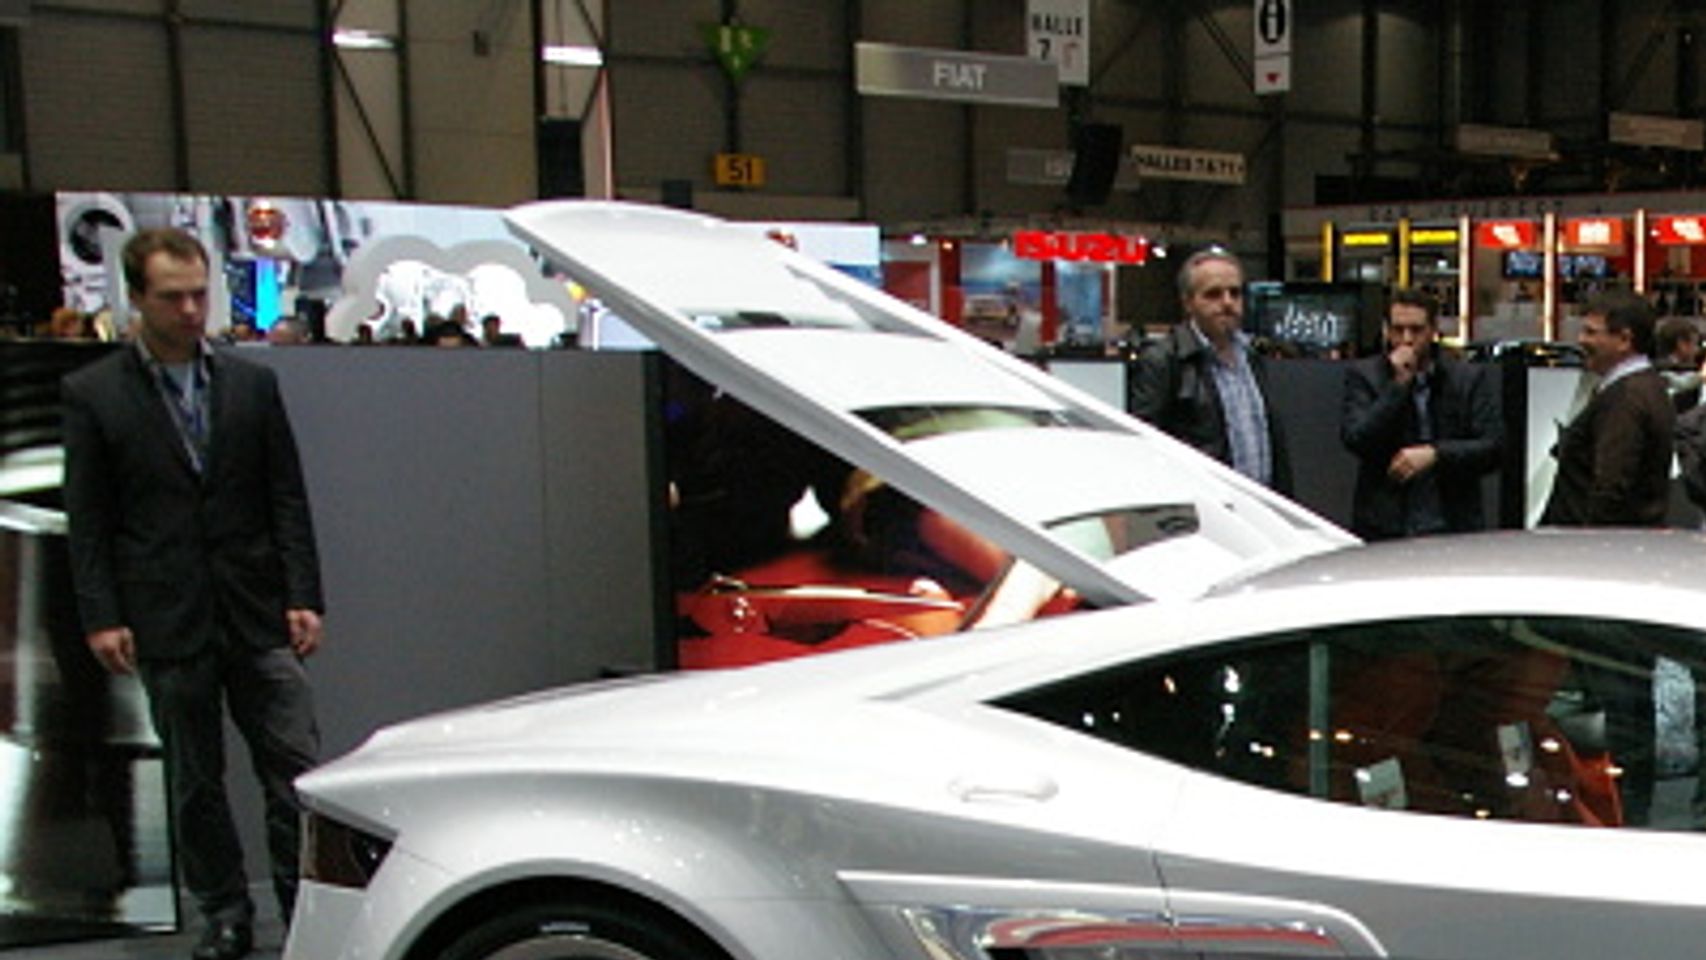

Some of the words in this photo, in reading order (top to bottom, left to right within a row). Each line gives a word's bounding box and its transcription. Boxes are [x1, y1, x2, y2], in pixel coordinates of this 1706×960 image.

[933, 61, 987, 91] FIAT
[728, 158, 753, 183] 51
[1014, 229, 1148, 265] ISUZU
